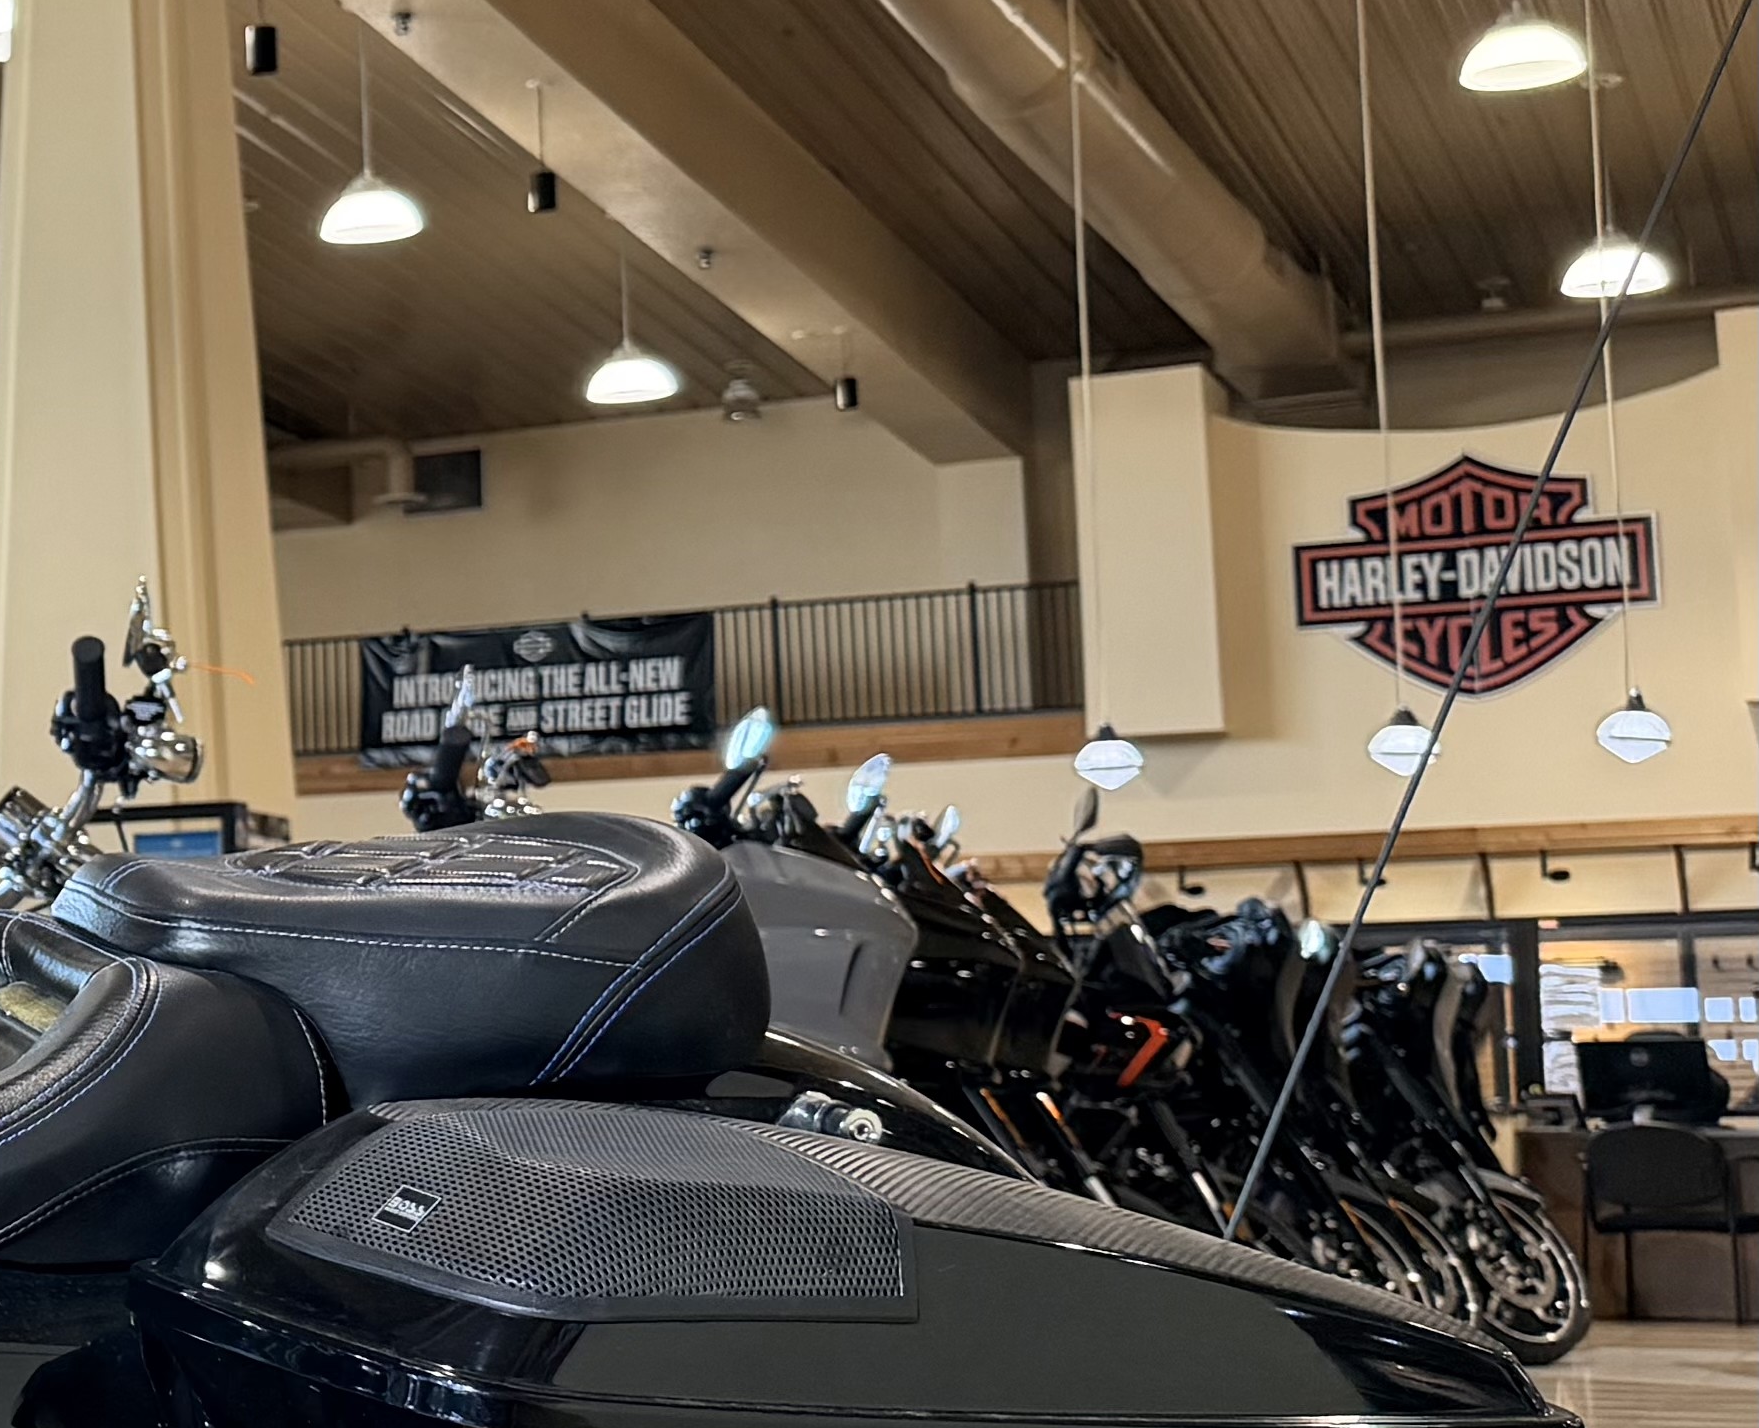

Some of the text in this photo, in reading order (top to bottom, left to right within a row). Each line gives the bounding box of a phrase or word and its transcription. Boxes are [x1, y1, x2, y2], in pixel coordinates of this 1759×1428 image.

[1392, 477, 1553, 538] MOTOR
[1316, 537, 1630, 609] HARLEY-DAVIDSON
[1398, 605, 1559, 673] CYCLES
[541, 663, 582, 698] THE
[584, 656, 681, 695] ALL-NEW
[382, 708, 437, 743] ROAD
[541, 696, 622, 734] STREET
[624, 691, 691, 728] GLIDE
